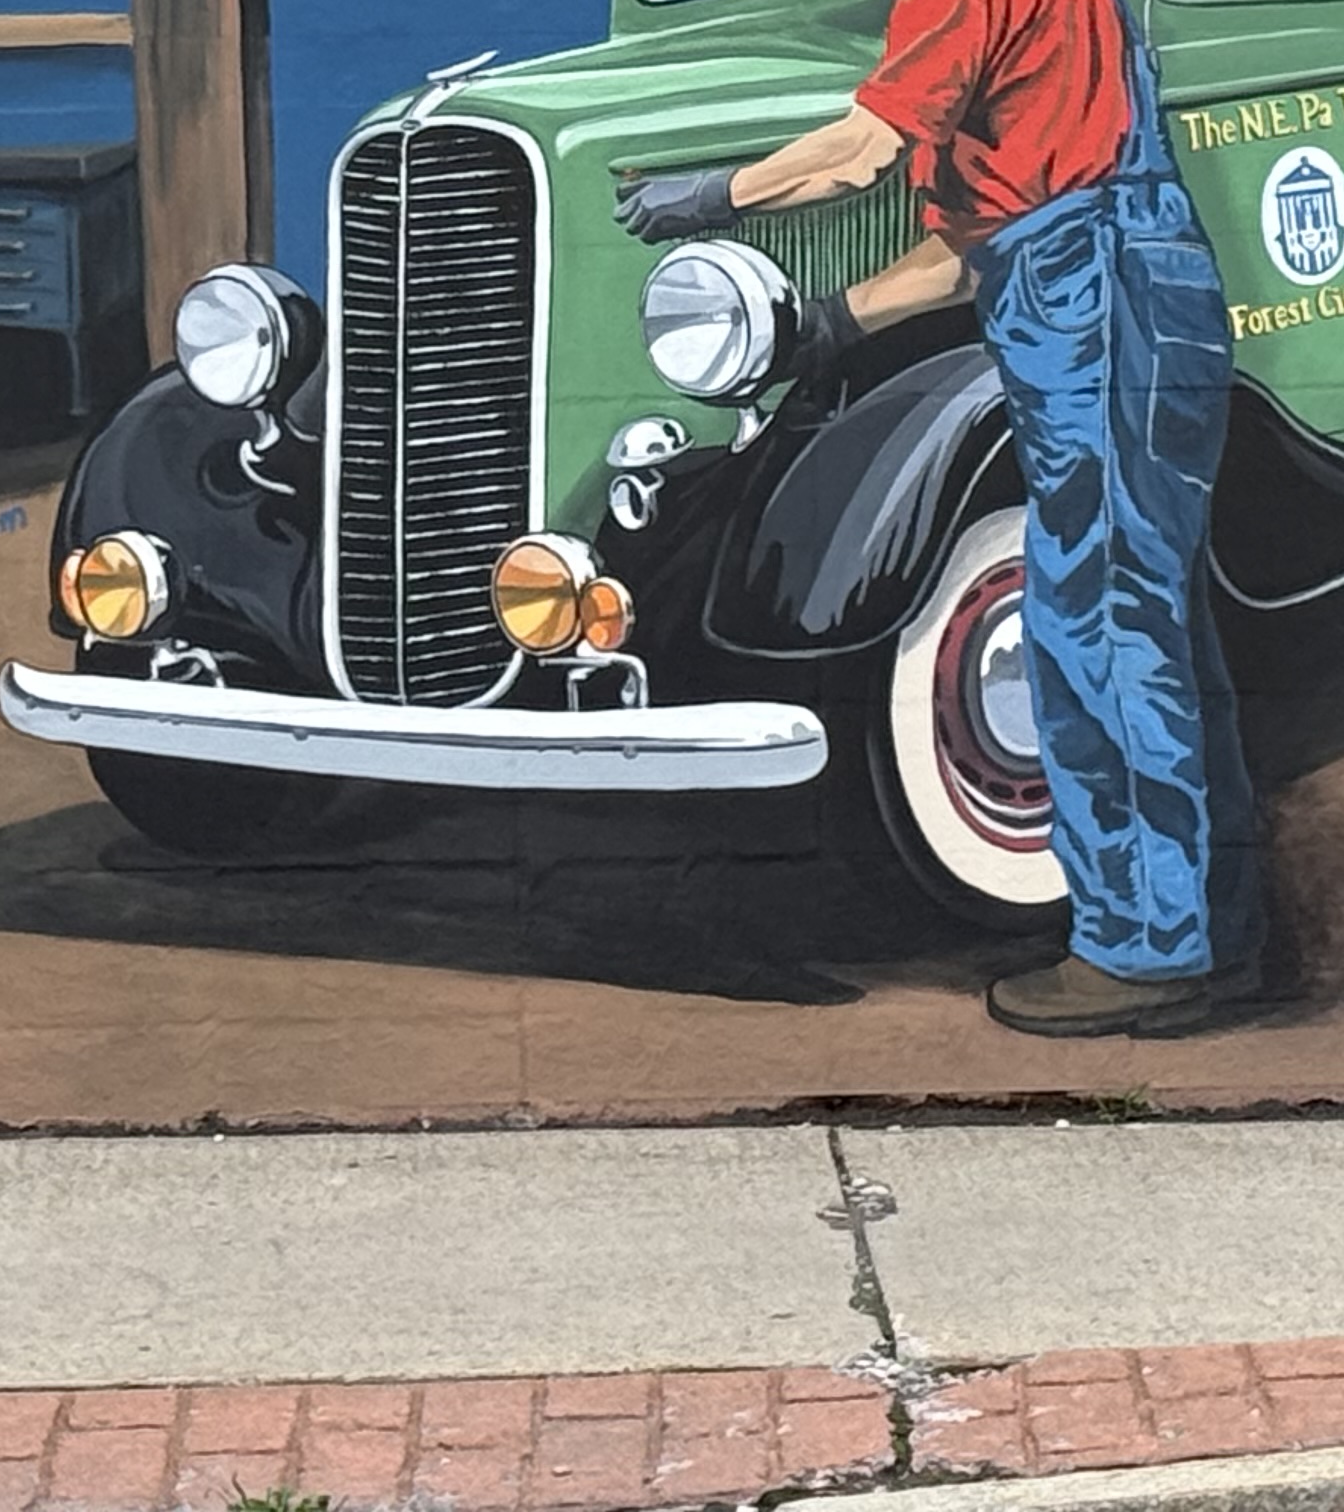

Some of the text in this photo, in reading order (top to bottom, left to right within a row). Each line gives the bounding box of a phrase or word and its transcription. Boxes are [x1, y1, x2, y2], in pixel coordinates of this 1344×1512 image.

[1179, 111, 1237, 151] The
[1296, 92, 1333, 131] Pa
[1227, 296, 1313, 340] Forest
